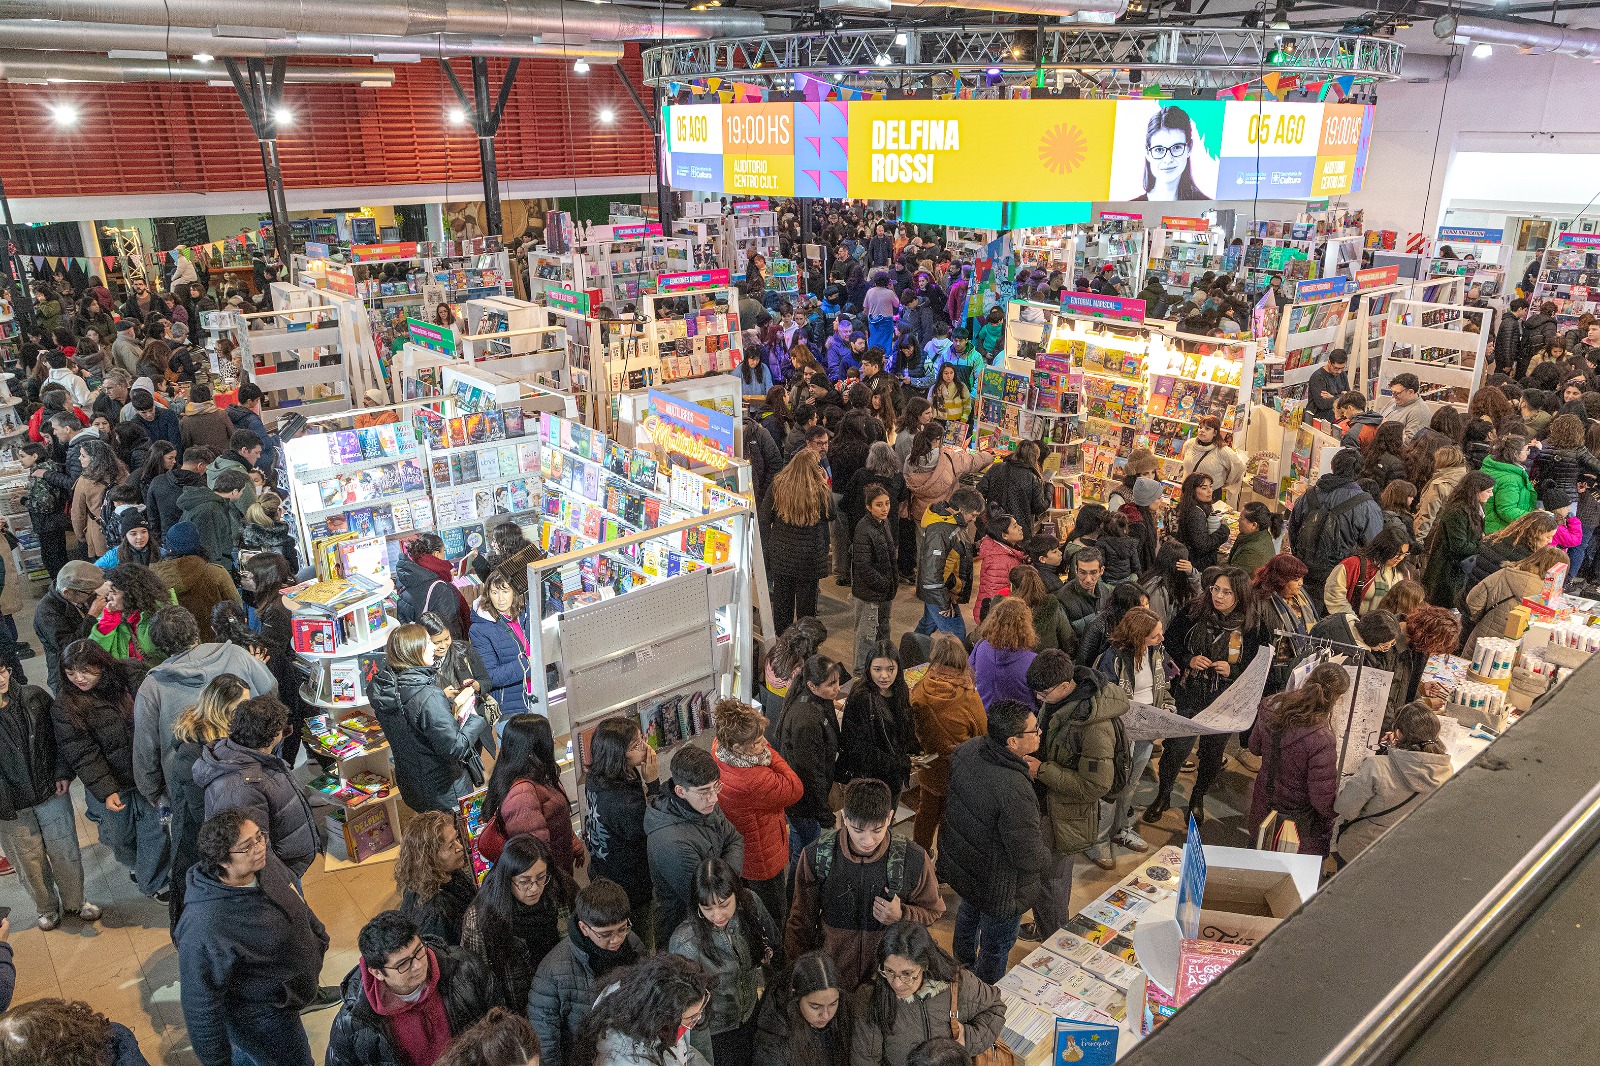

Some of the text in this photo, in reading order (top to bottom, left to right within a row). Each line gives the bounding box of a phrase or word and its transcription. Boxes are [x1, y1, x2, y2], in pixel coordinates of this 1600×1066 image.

[676, 115, 708, 143] 05 AGO
[726, 114, 790, 145] 19:00 HS
[871, 119, 960, 150] DELFINA
[1247, 114, 1306, 144] 05 AGO
[1324, 116, 1362, 146] 19:00 HS
[734, 160, 768, 174] AUDITORIO
[871, 153, 934, 184] ROSSI
[1280, 176, 1302, 184] Cultura
[734, 174, 779, 189] CENTRO CULT.
[354, 810, 384, 833] DELFINA
[1188, 964, 1202, 974] EL
